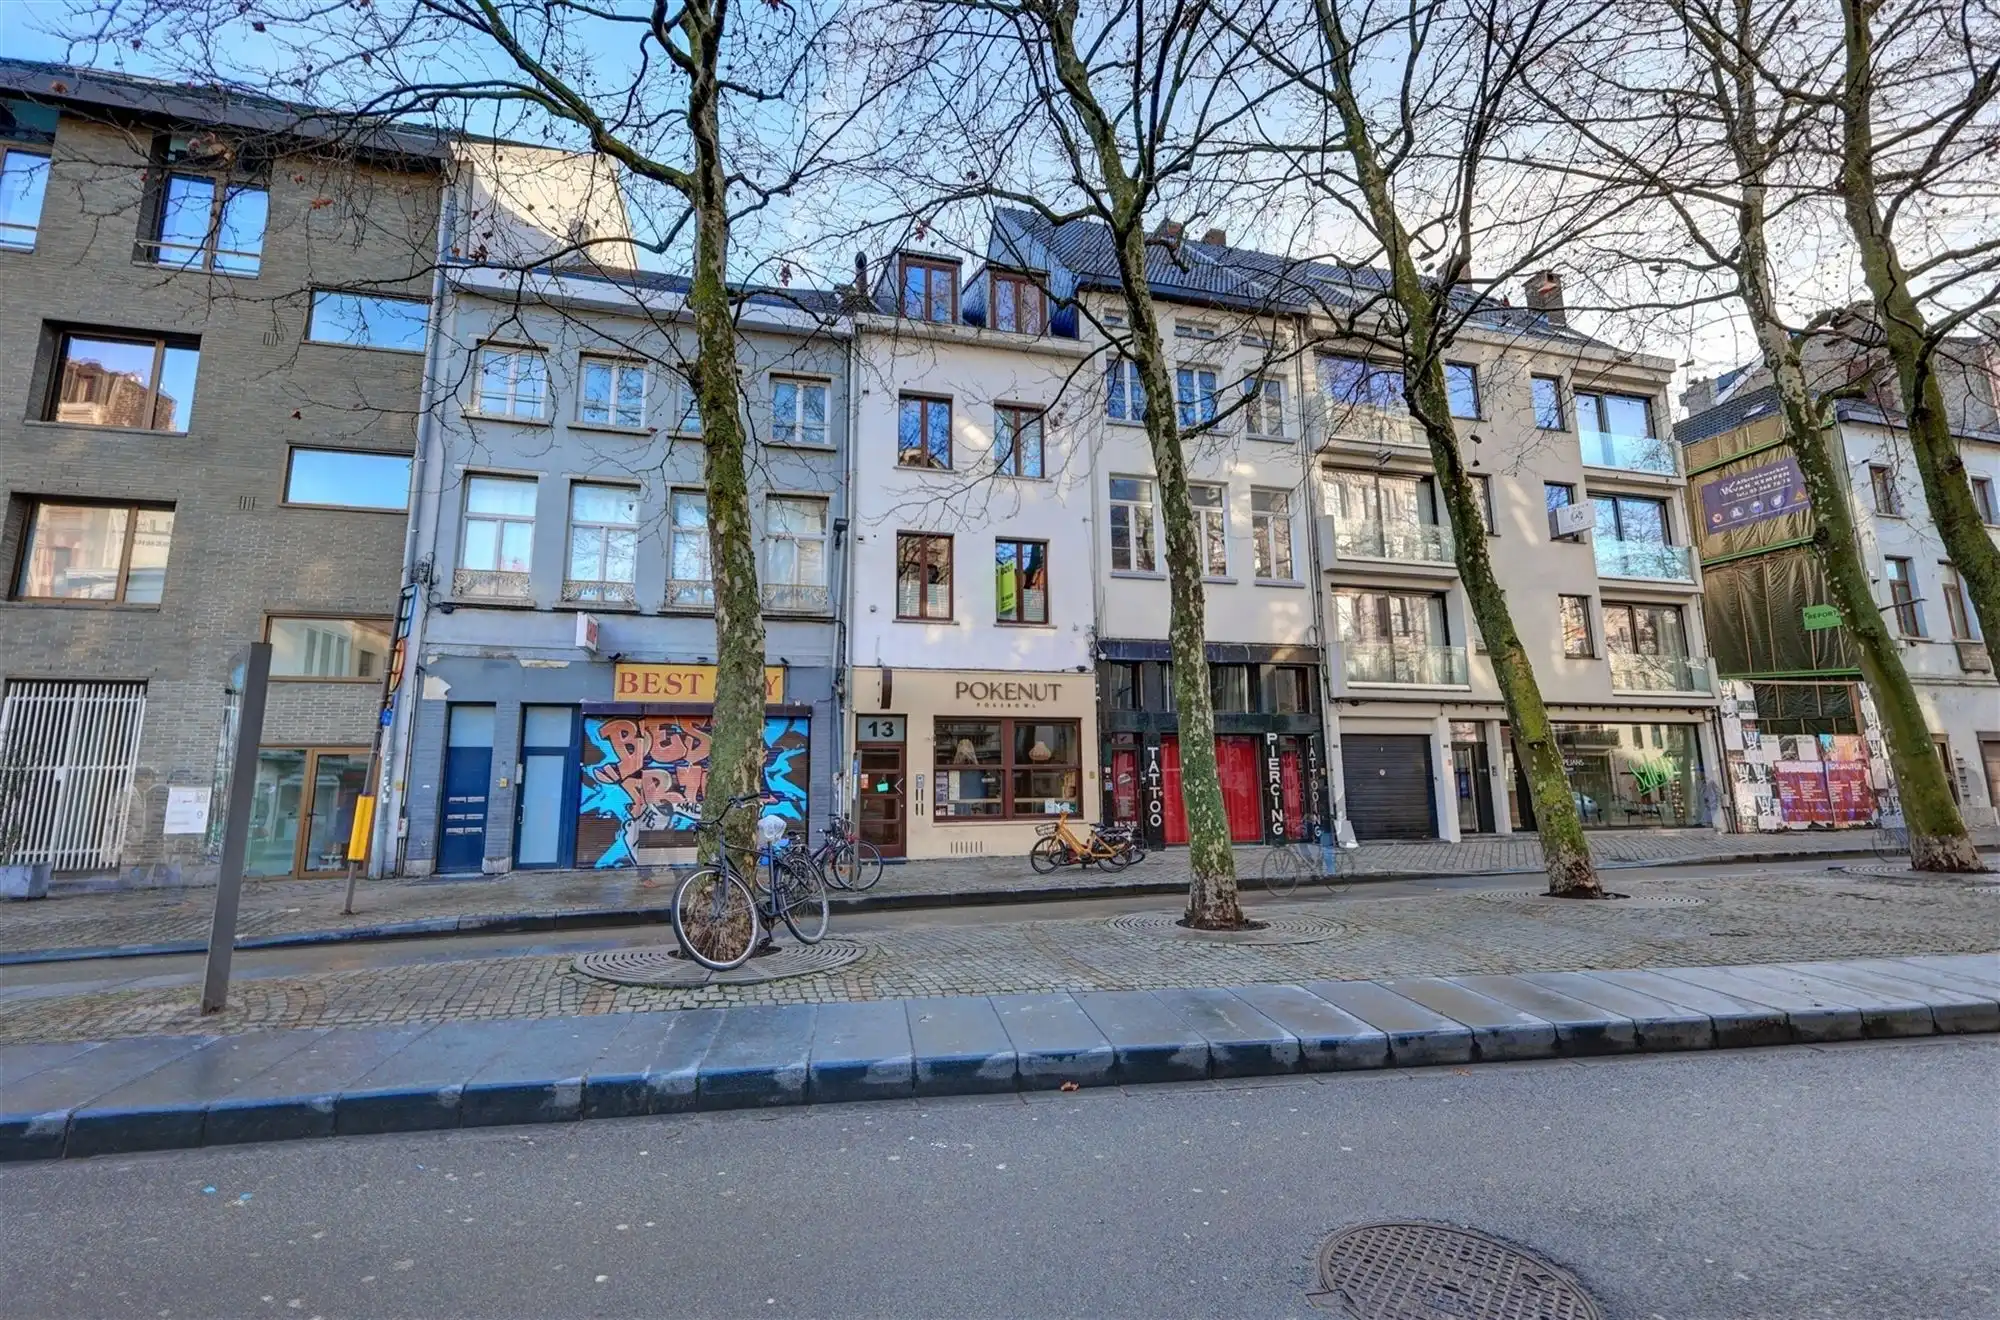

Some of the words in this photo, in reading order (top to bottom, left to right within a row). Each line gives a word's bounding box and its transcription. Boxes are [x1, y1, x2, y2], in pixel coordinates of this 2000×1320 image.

[618, 671, 704, 696] BEST
[956, 681, 1063, 701] POKENUT
[868, 721, 894, 737] 13
[1147, 746, 1162, 827] TATTOO
[1266, 732, 1284, 835] PIERCING
[1308, 735, 1322, 837] TATTOOING
